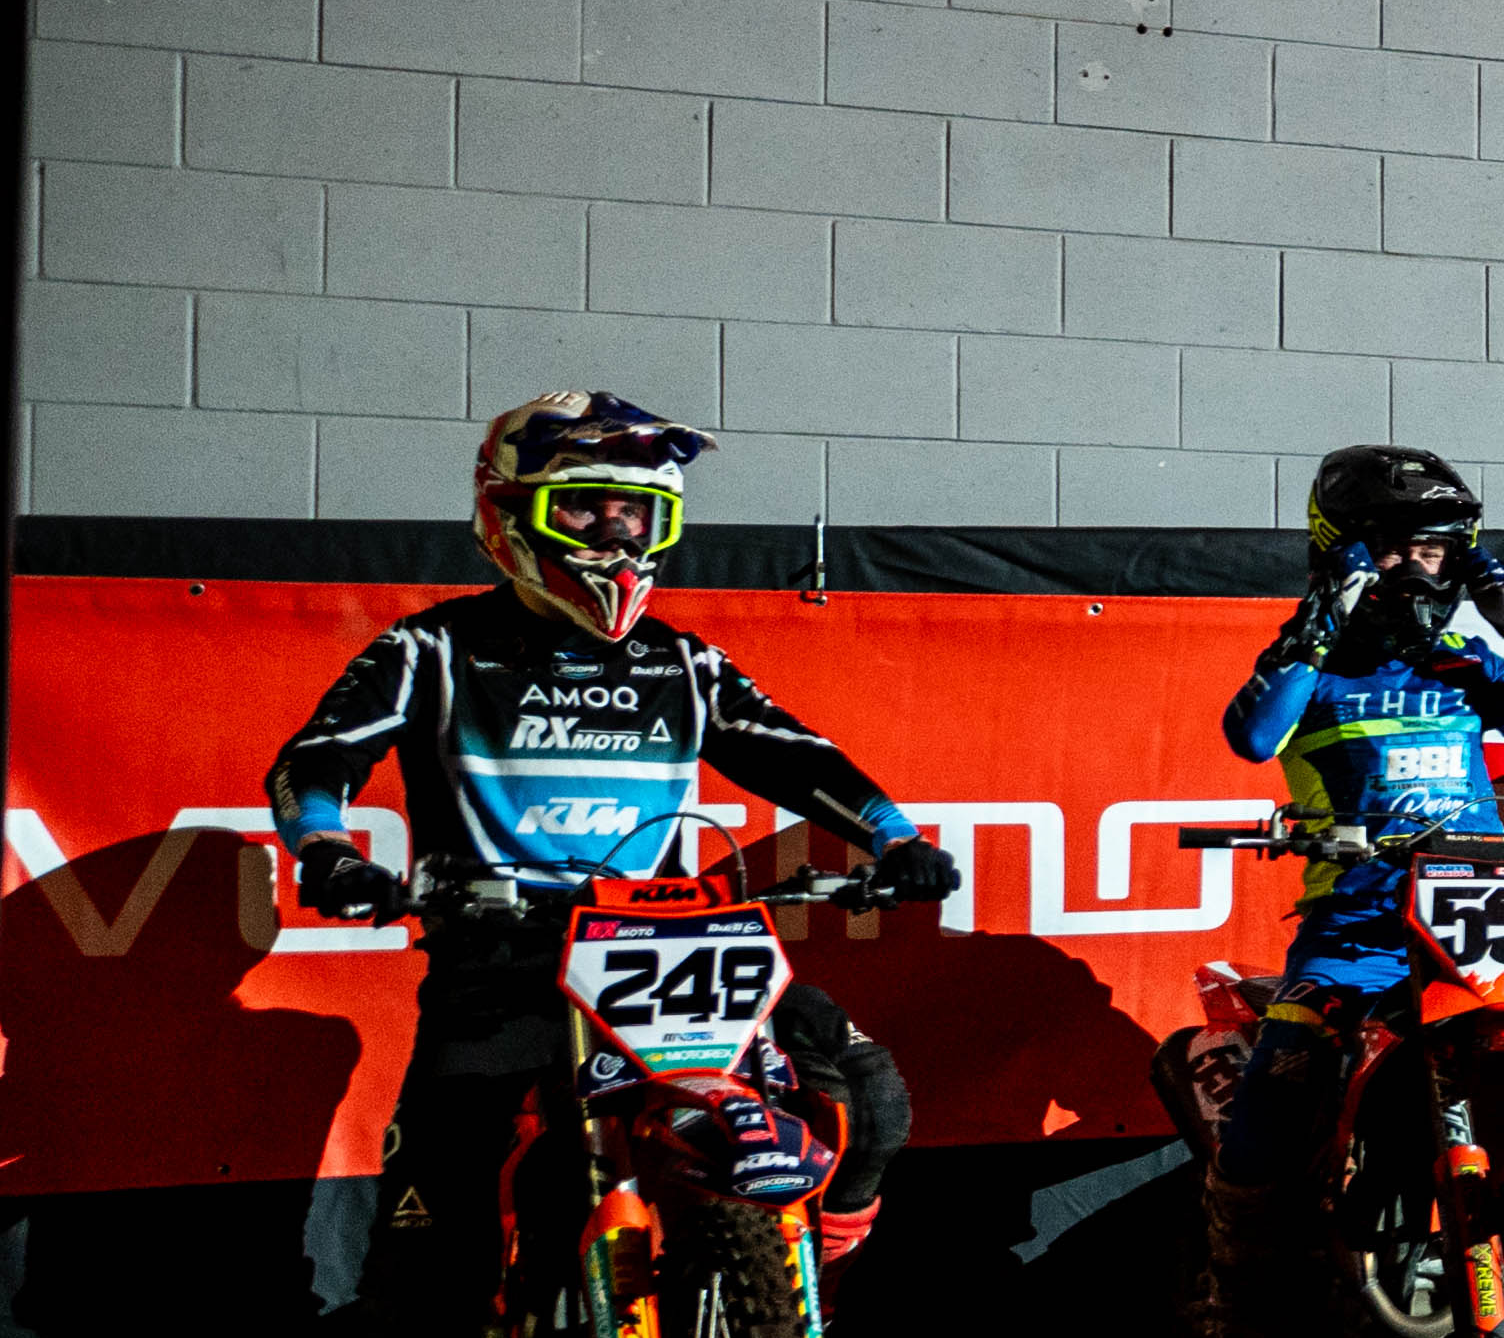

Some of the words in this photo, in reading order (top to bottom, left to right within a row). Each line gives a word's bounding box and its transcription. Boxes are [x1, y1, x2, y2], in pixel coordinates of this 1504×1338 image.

[518, 683, 639, 711] AMOQ
[1385, 745, 1468, 782] BBL
[514, 797, 641, 836] KTM
[630, 884, 699, 904] KTM
[596, 945, 776, 1027] 248
[732, 1152, 800, 1175] KTM
